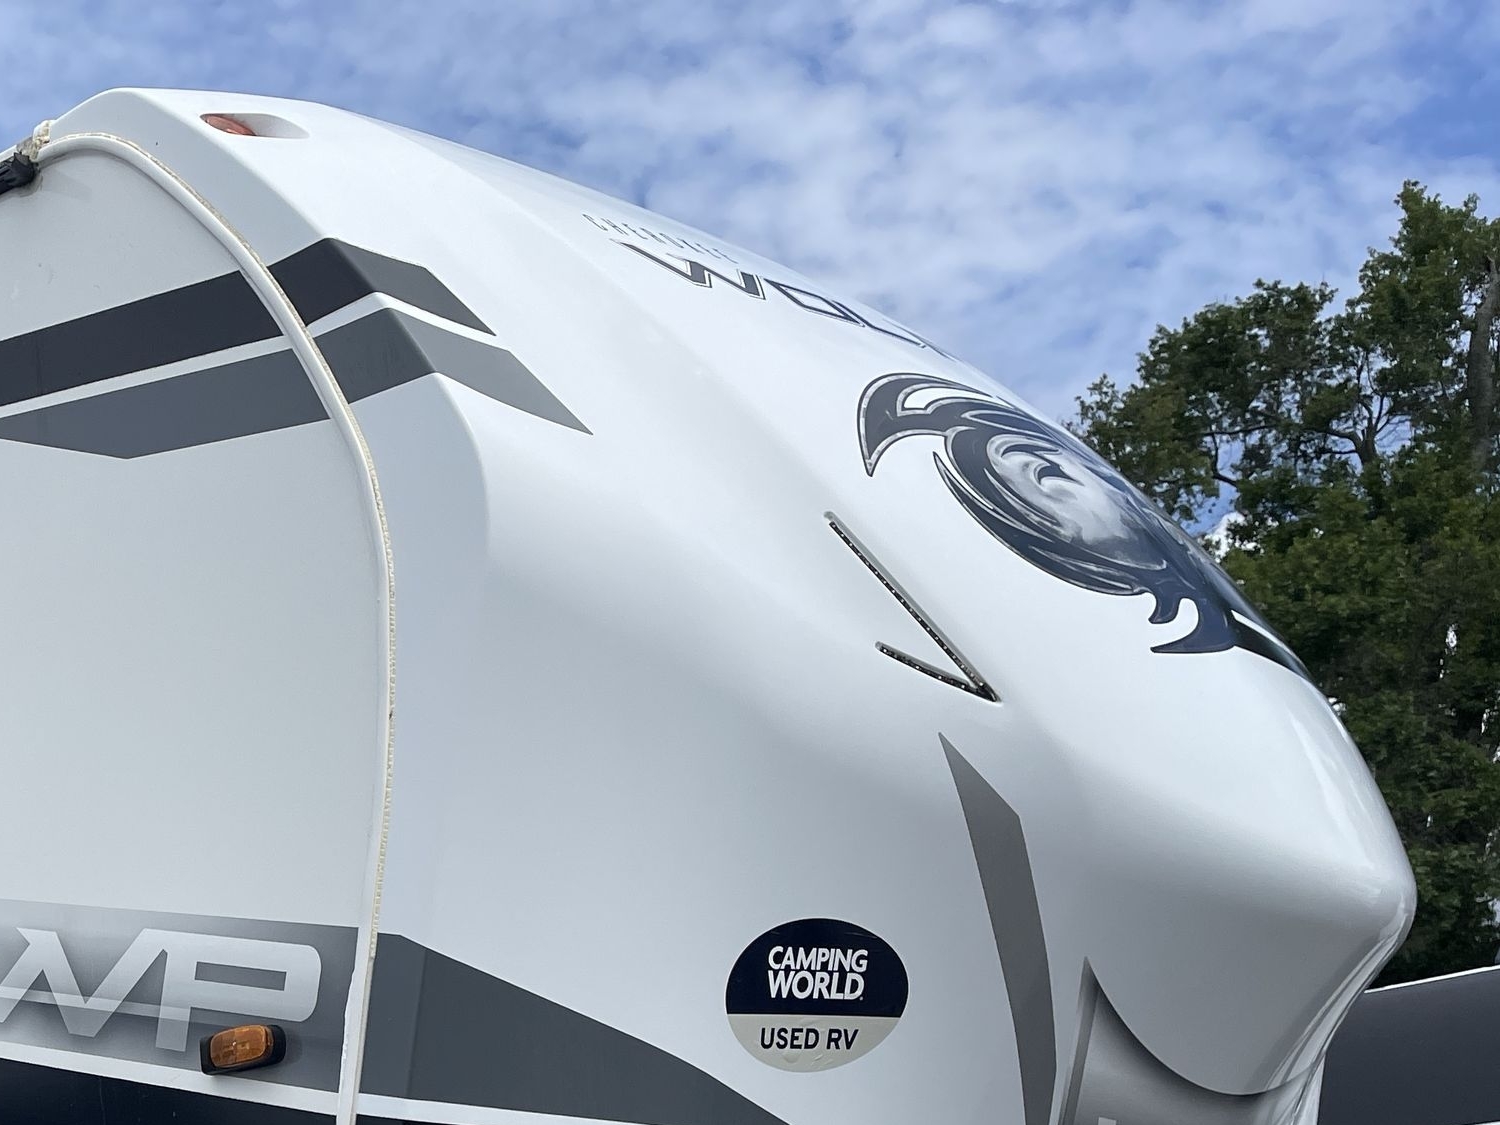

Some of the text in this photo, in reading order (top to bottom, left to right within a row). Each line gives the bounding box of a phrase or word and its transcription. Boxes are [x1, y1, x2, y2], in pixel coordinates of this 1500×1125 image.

[768, 946, 868, 973] CAMPING
[768, 970, 865, 1000] WORLD
[760, 1027, 859, 1050] USED RV
